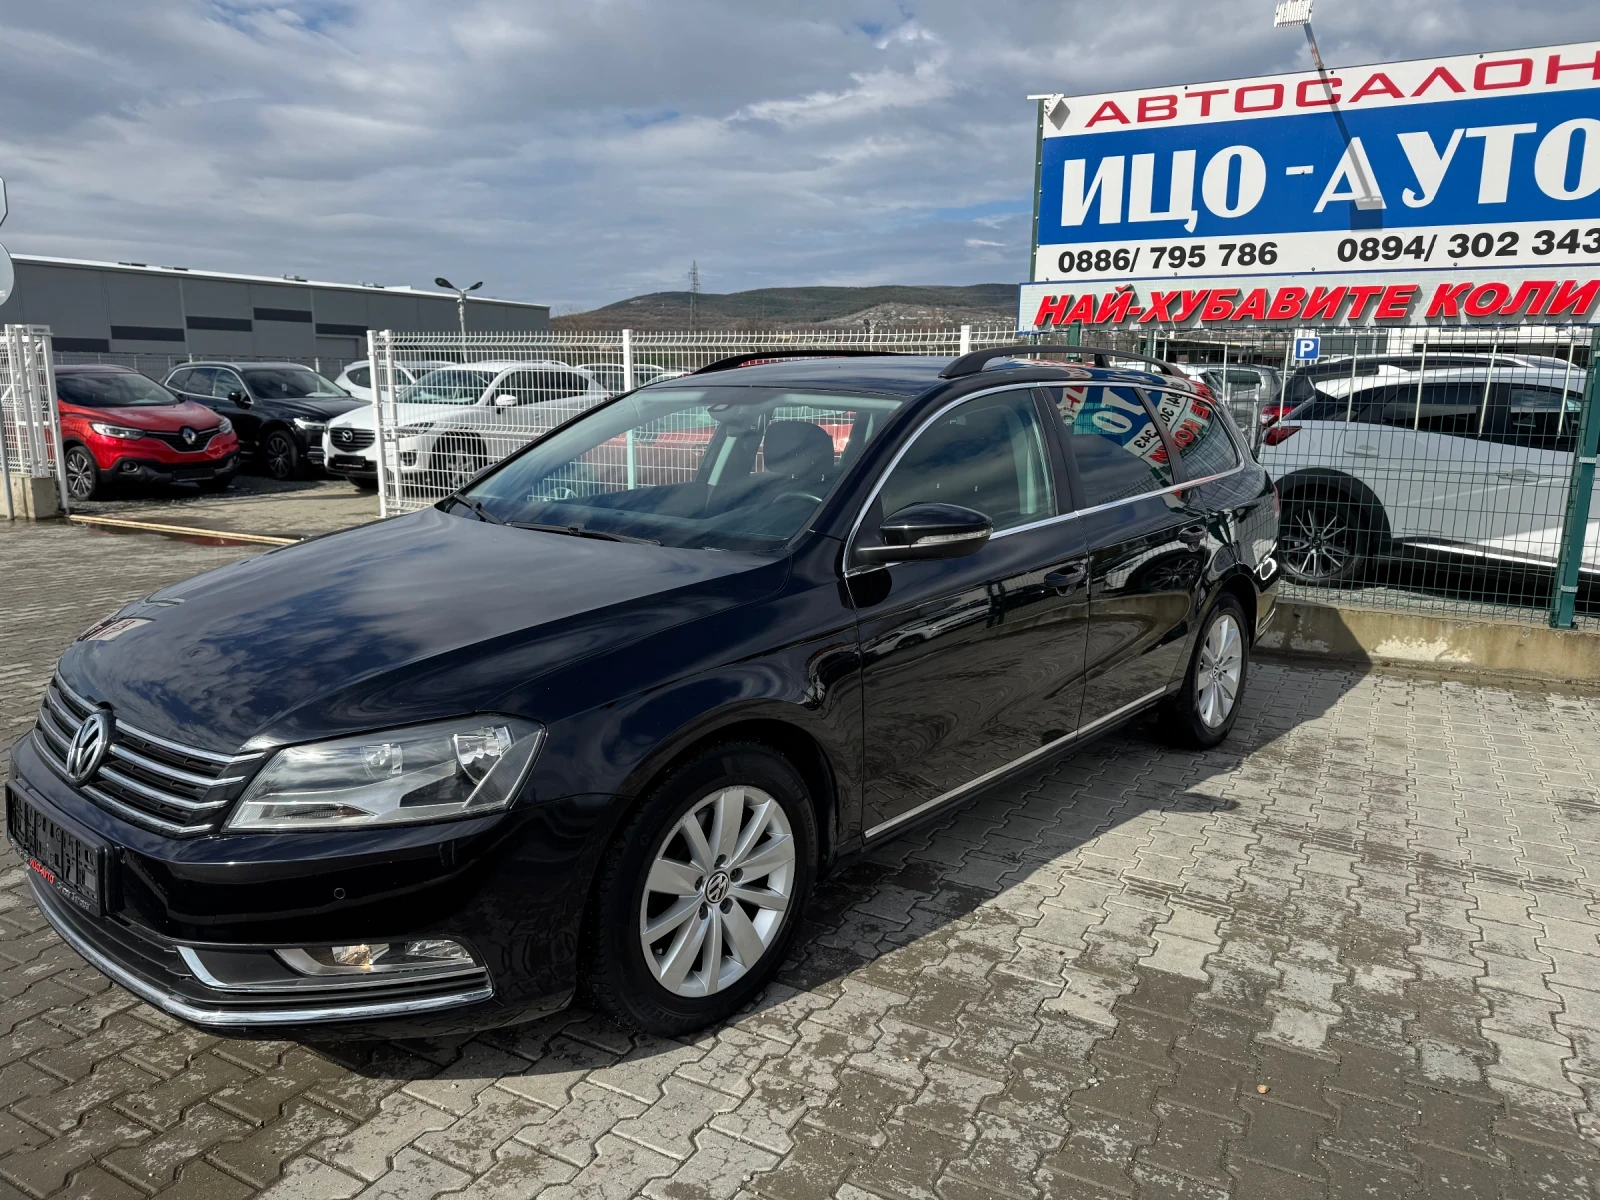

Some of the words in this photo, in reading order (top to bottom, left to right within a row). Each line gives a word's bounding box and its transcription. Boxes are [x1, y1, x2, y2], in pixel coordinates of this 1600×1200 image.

[1085, 50, 1600, 128] АВТОСАЛОН
[1060, 145, 1267, 233] ИЦО
[1058, 247, 1141, 273] 0886/
[1150, 244, 1206, 269] 795
[1218, 241, 1278, 267] 786
[1337, 234, 1438, 264] 0894/
[1447, 231, 1520, 259] 302
[1531, 228, 1600, 256] 343
[1034, 283, 1418, 326] НАЙ-ХУБАВИТЕ
[1426, 279, 1600, 318] КОЛИ
[1300, 340, 1315, 357] P
